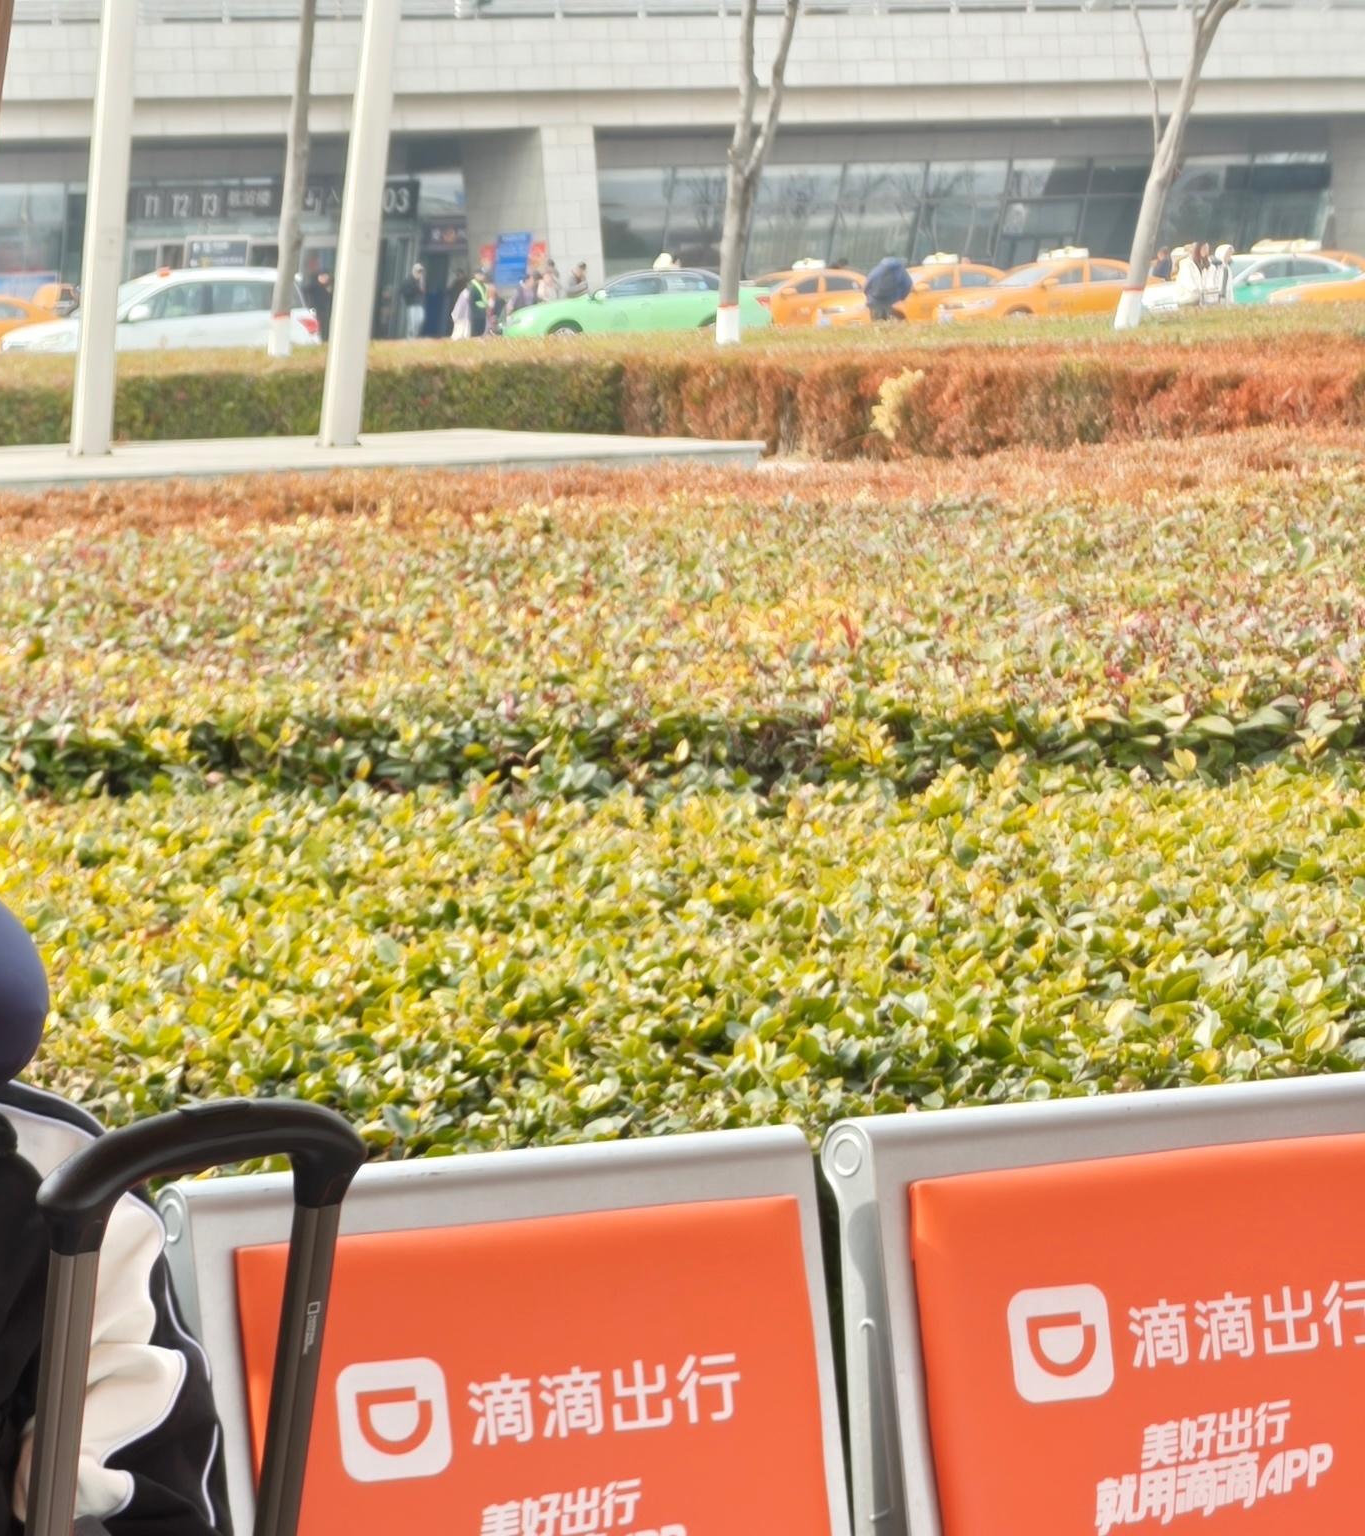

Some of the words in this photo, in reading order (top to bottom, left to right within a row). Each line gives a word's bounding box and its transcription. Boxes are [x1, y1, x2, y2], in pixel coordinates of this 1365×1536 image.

[144, 192, 160, 218] T1
[172, 192, 190, 218] T2
[201, 192, 219, 218] T3
[1128, 1279, 1365, 1369] 滴滴出行
[468, 1351, 742, 1447] 滴滴出行
[1141, 1398, 1291, 1470] 美好出行
